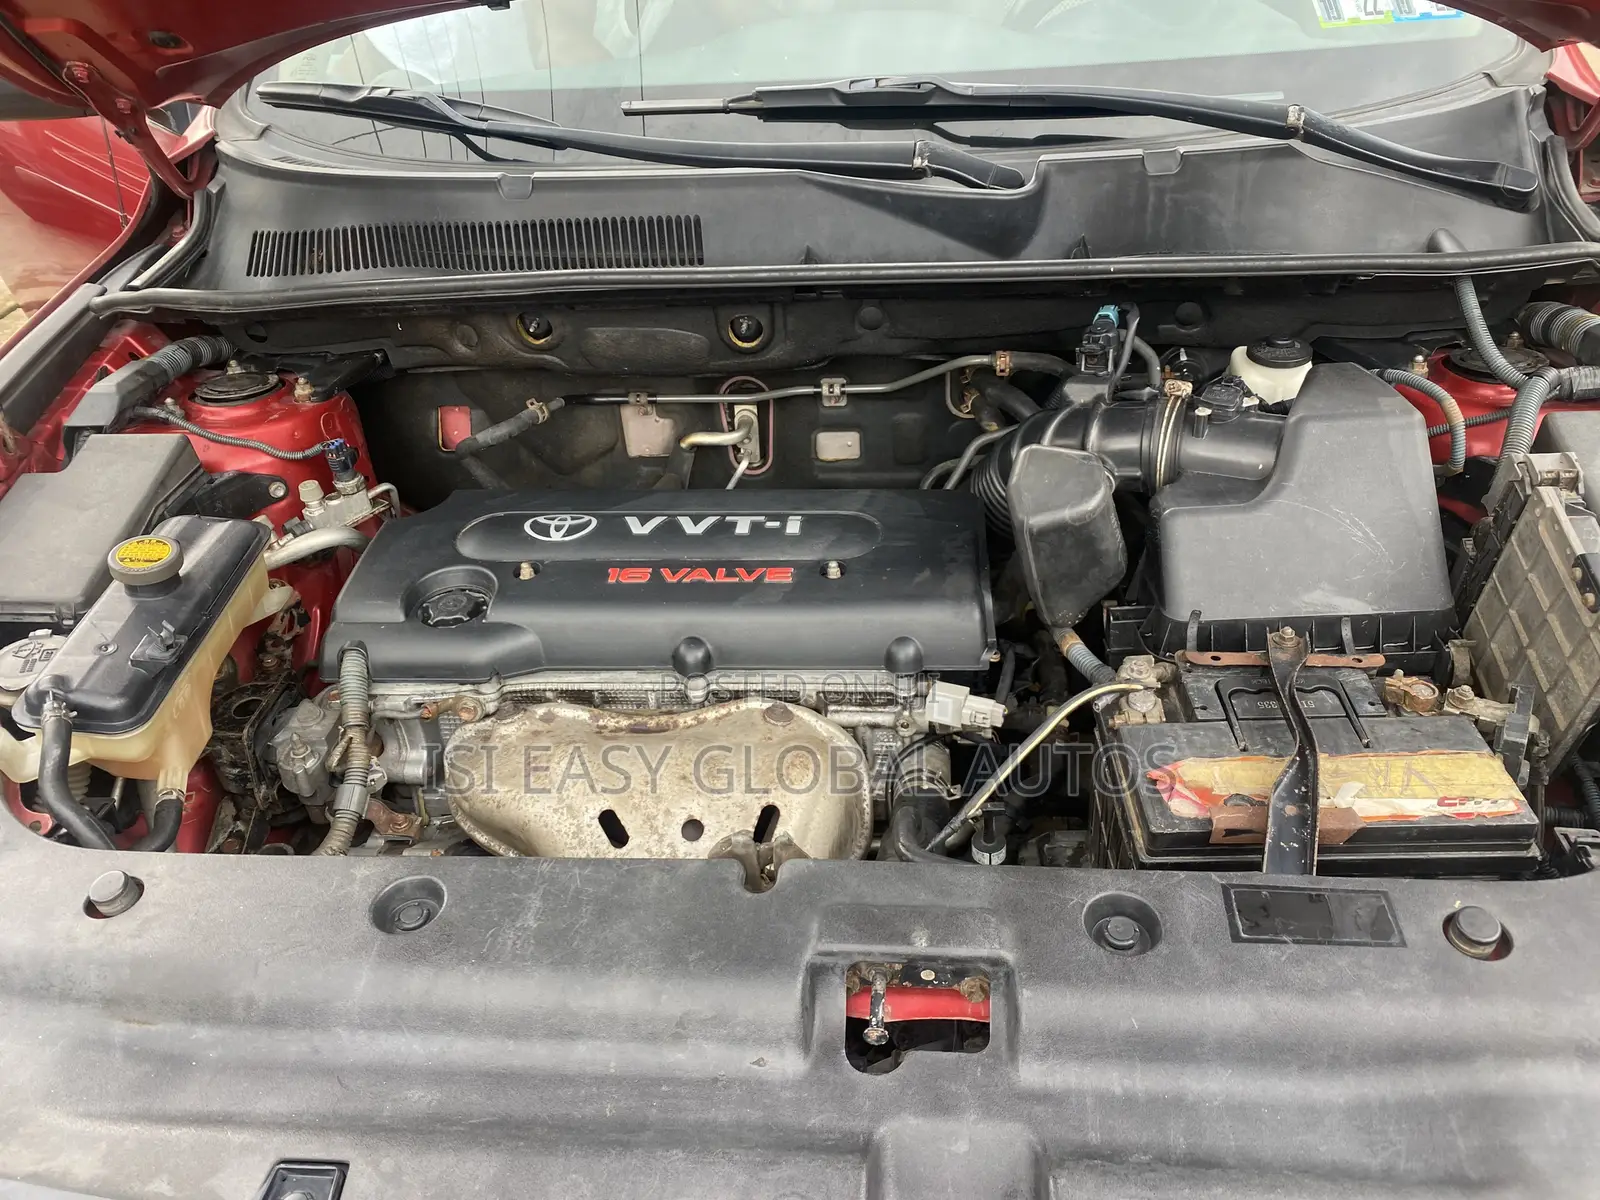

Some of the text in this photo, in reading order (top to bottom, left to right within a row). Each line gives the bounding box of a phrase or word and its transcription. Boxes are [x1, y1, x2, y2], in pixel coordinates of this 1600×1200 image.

[624, 515, 803, 535] VVT-i
[607, 567, 795, 583] 16 VALVE
